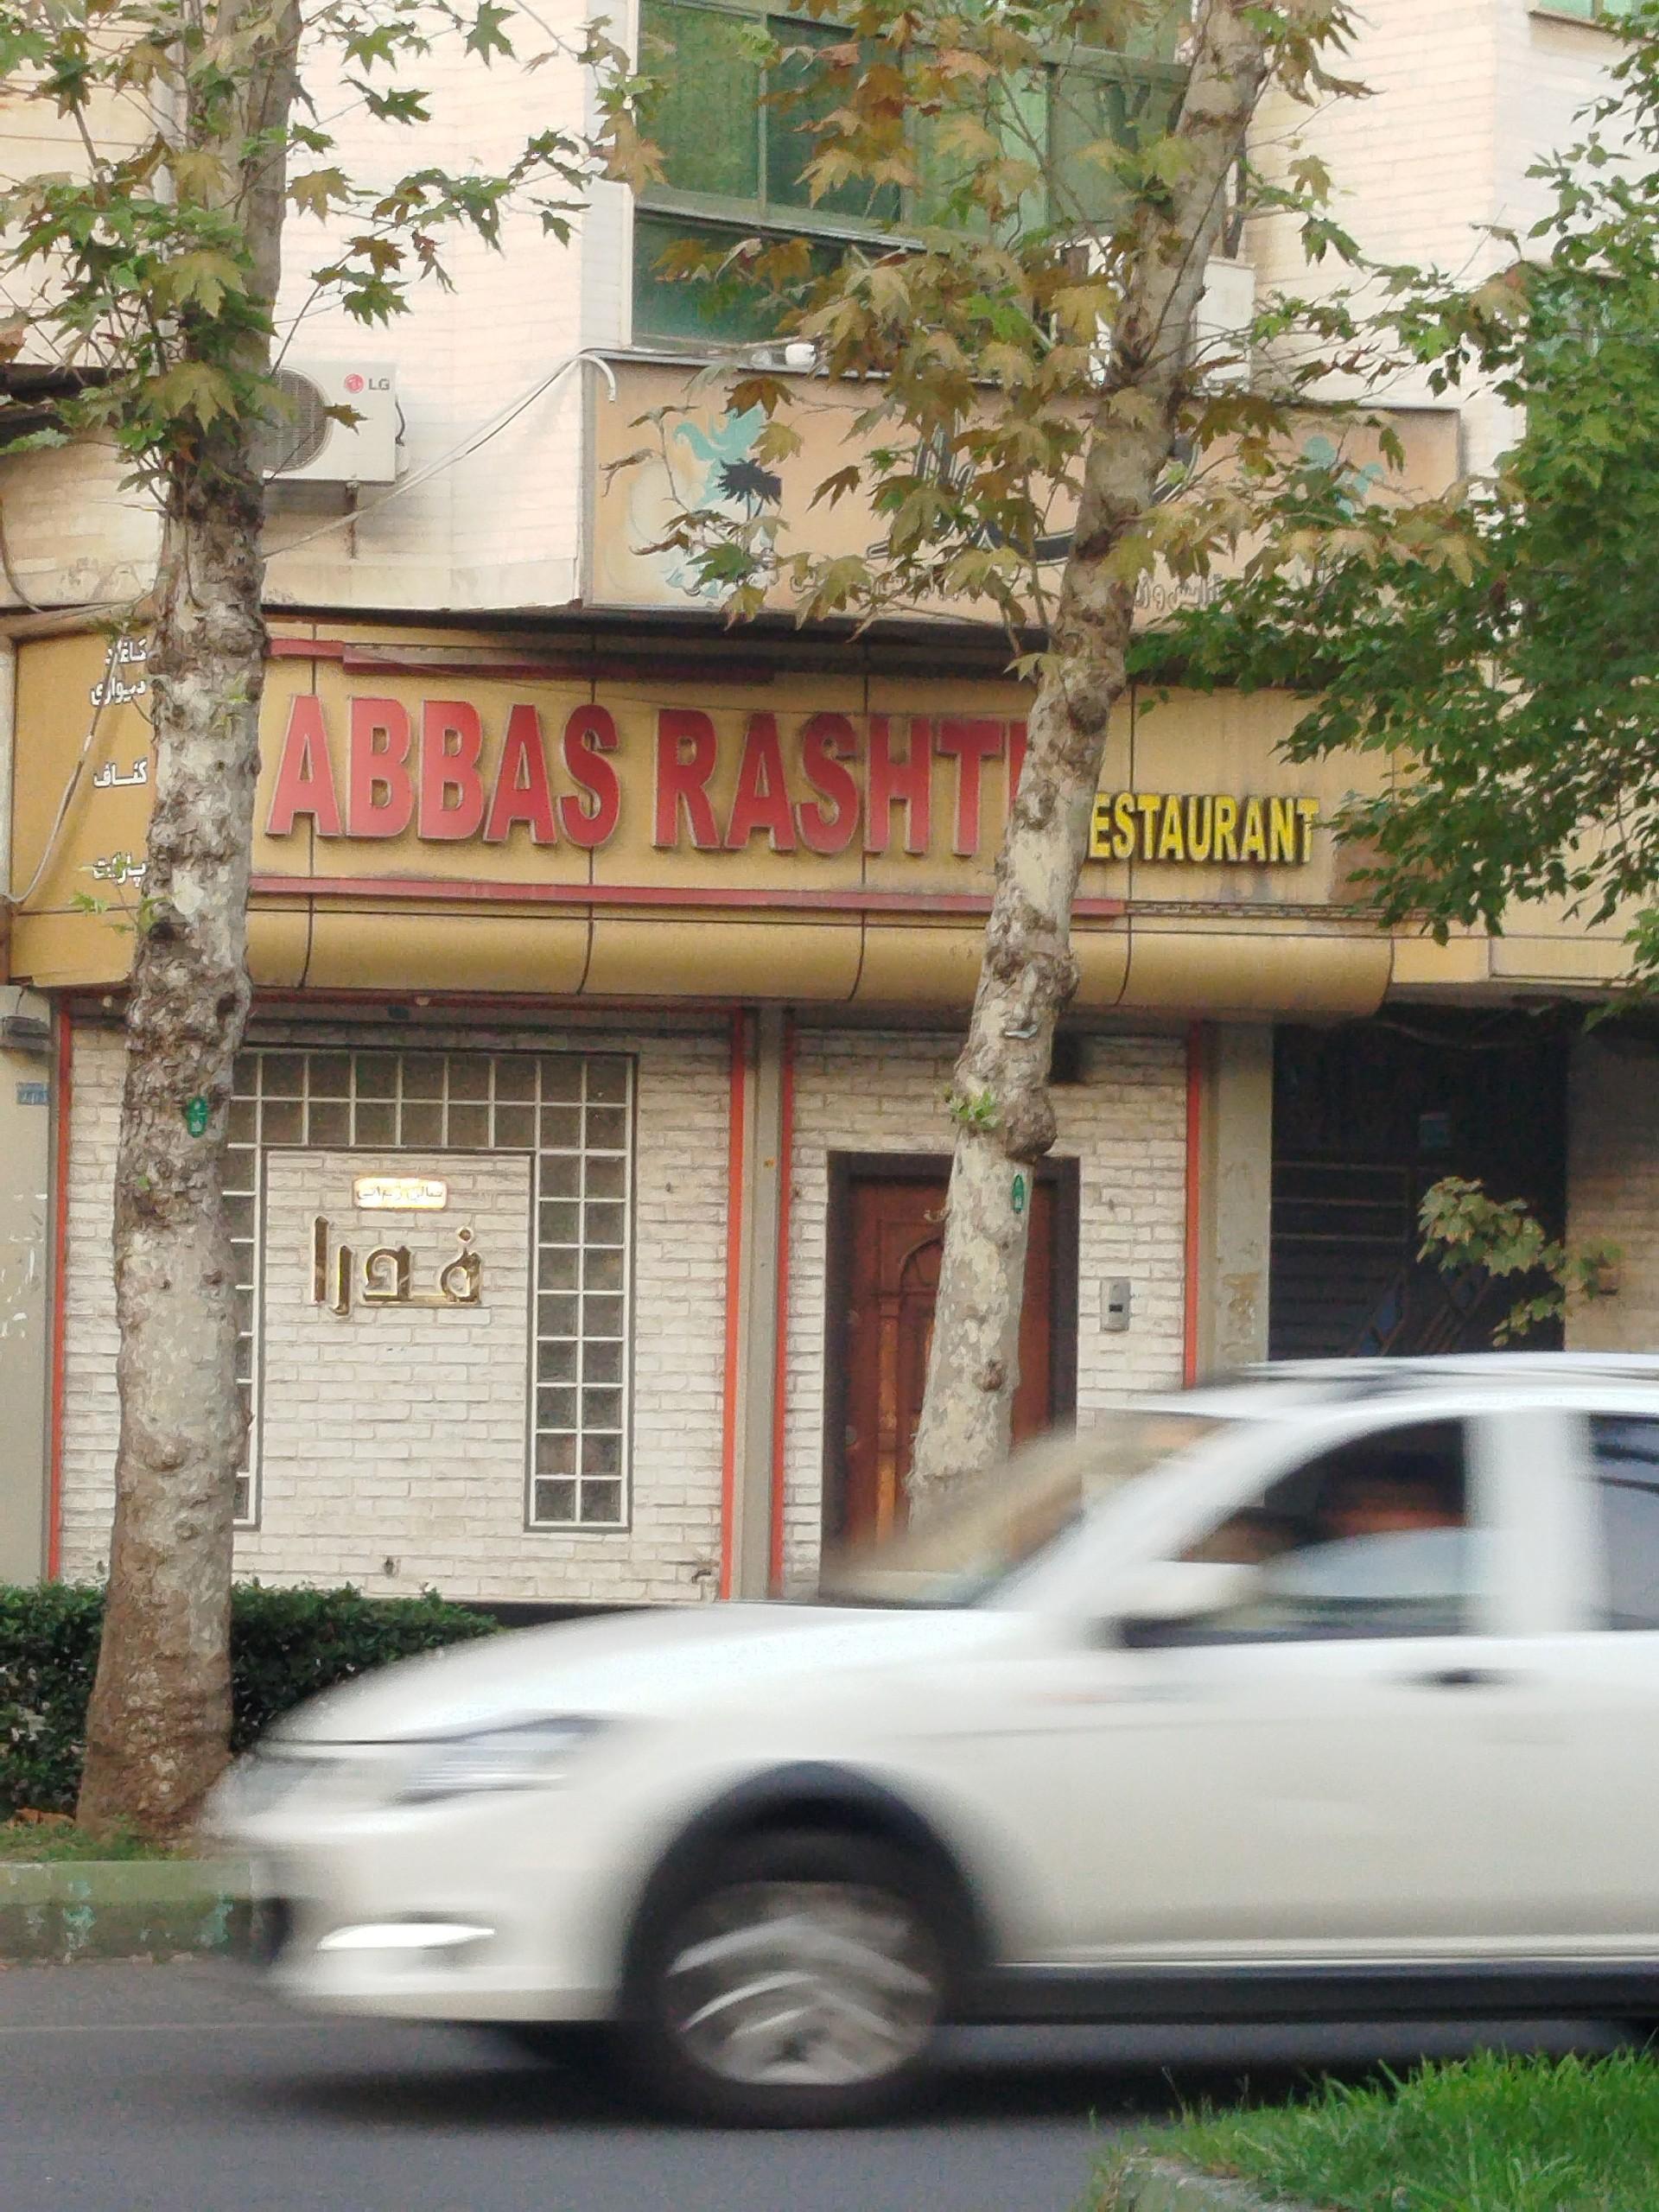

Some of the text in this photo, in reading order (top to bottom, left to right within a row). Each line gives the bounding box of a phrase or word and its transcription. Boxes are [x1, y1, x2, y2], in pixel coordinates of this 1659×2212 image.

[368, 378, 391, 391] LG
[265, 693, 621, 849] ABBAS
[1088, 791, 1319, 862] ESTAURANT
